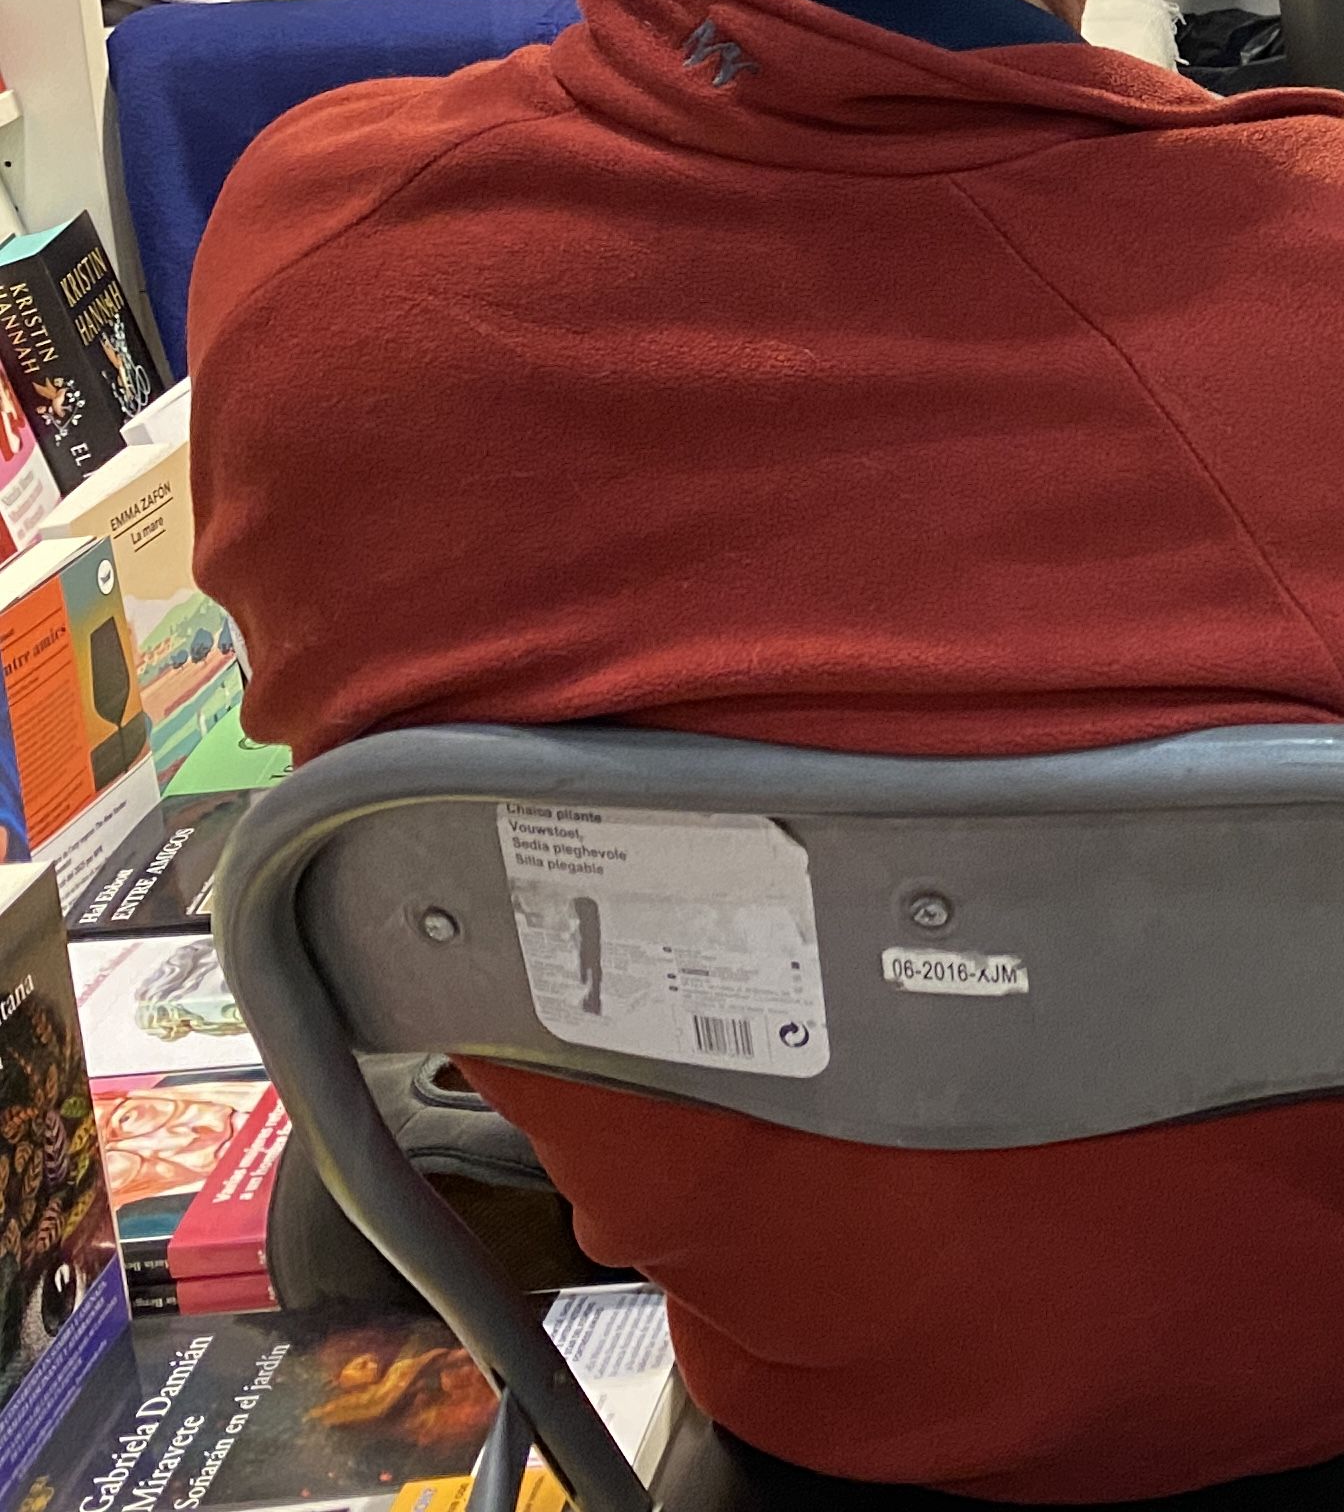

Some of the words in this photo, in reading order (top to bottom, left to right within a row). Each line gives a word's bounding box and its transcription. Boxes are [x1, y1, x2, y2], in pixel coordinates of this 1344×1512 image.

[58, 246, 108, 309] KRISTIN
[9, 282, 60, 363] KRISTIN
[75, 280, 125, 347] HANNAH
[70, 442, 91, 468] EL
[110, 503, 142, 532] EMMA
[140, 480, 172, 512] ZAFÓN
[131, 532, 143, 545] La
[3, 650, 30, 676] ntre
[111, 876, 158, 921] ENTRE
[146, 827, 196, 875] AMIGOS
[512, 837, 549, 852] Sedia
[552, 843, 627, 862] pieghevole
[515, 853, 544, 867] Silla
[547, 857, 605, 876] plegable
[243, 1343, 291, 1391] jardín
[79, 1421, 160, 1512] Gabriela
[135, 1335, 214, 1419] Damián
[225, 1412, 249, 1434] en
[234, 1394, 260, 1410] el
[120, 1414, 205, 1512] Miravete
[173, 1438, 235, 1510] Soñarán
